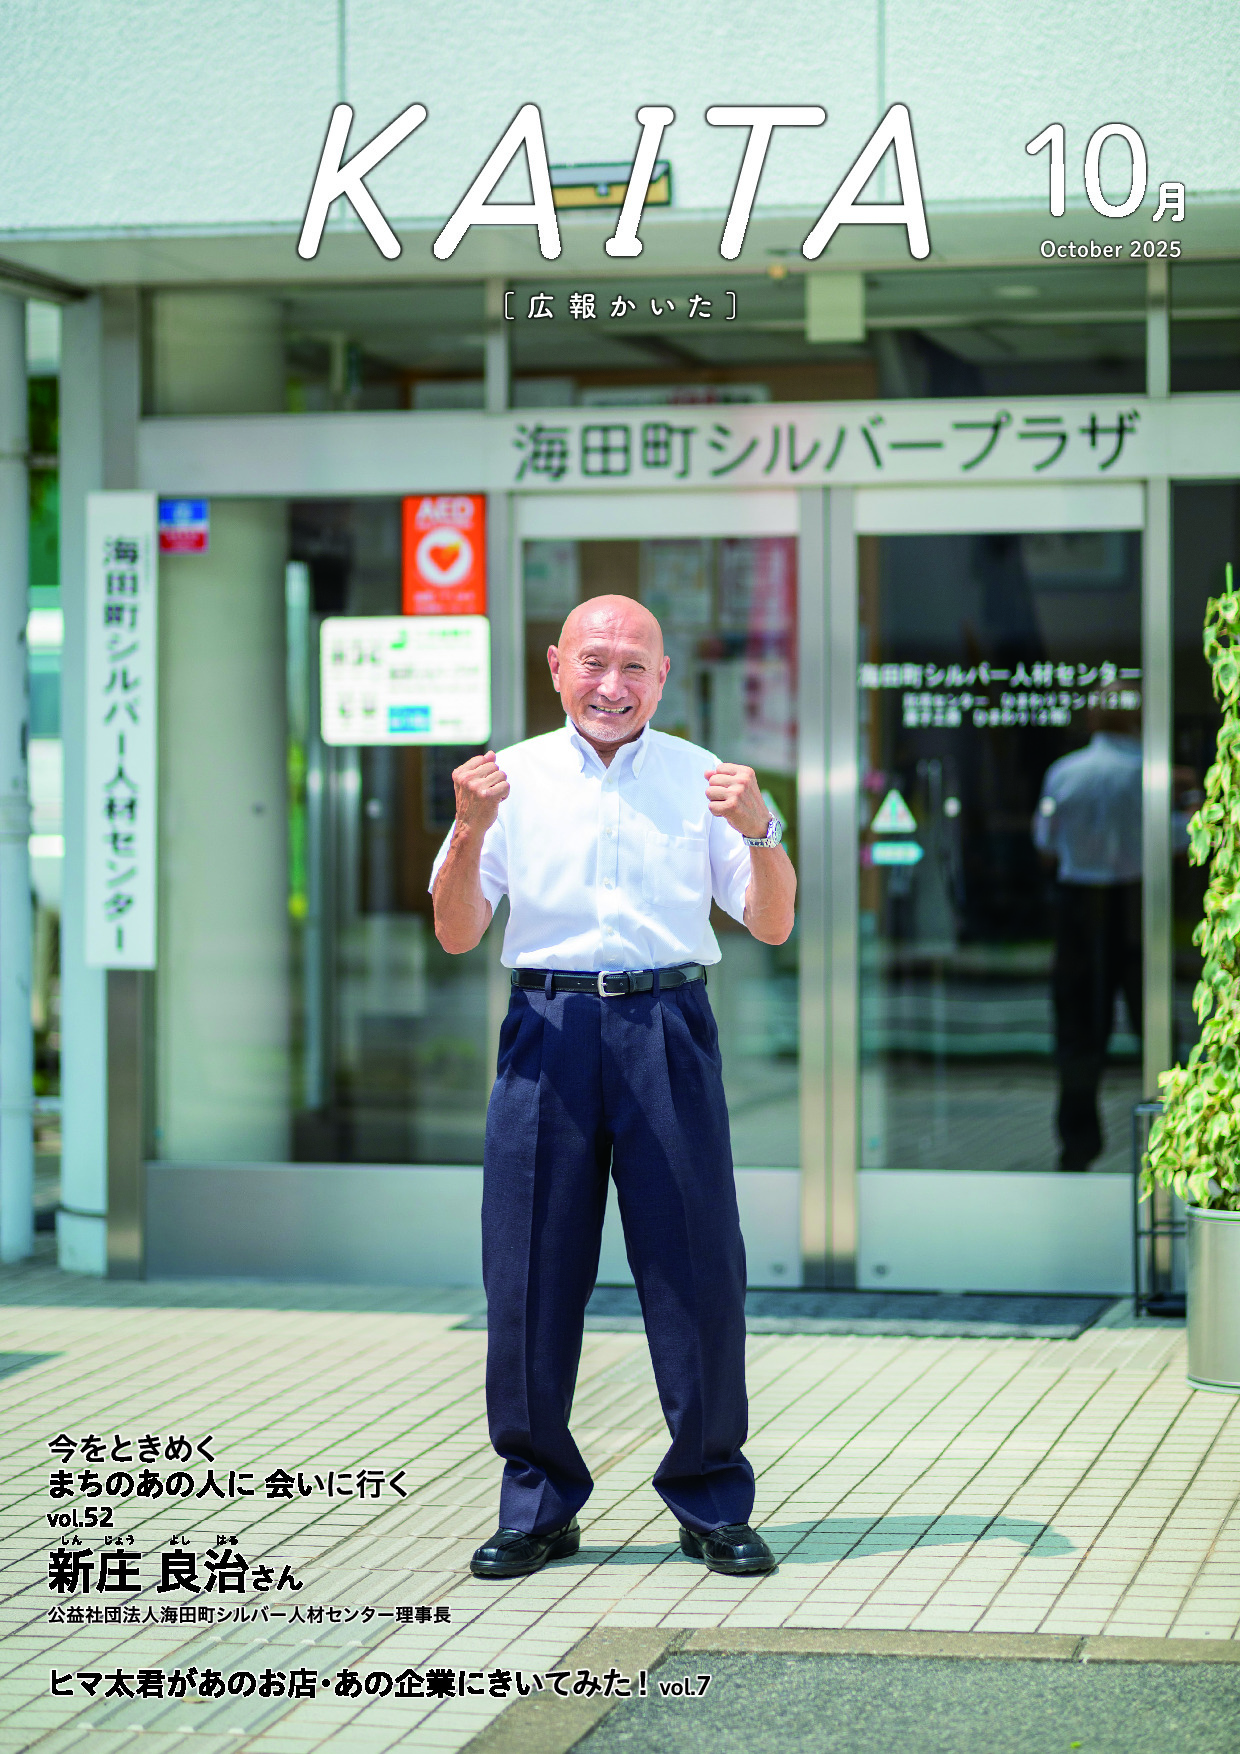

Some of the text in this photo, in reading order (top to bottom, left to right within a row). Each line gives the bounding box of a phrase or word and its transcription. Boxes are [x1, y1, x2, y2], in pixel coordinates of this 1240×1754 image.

[512, 410, 1140, 481] 海田町シルバープラザ
[416, 497, 475, 522] AED
[102, 535, 141, 953] 海田町シルバー人材センター
